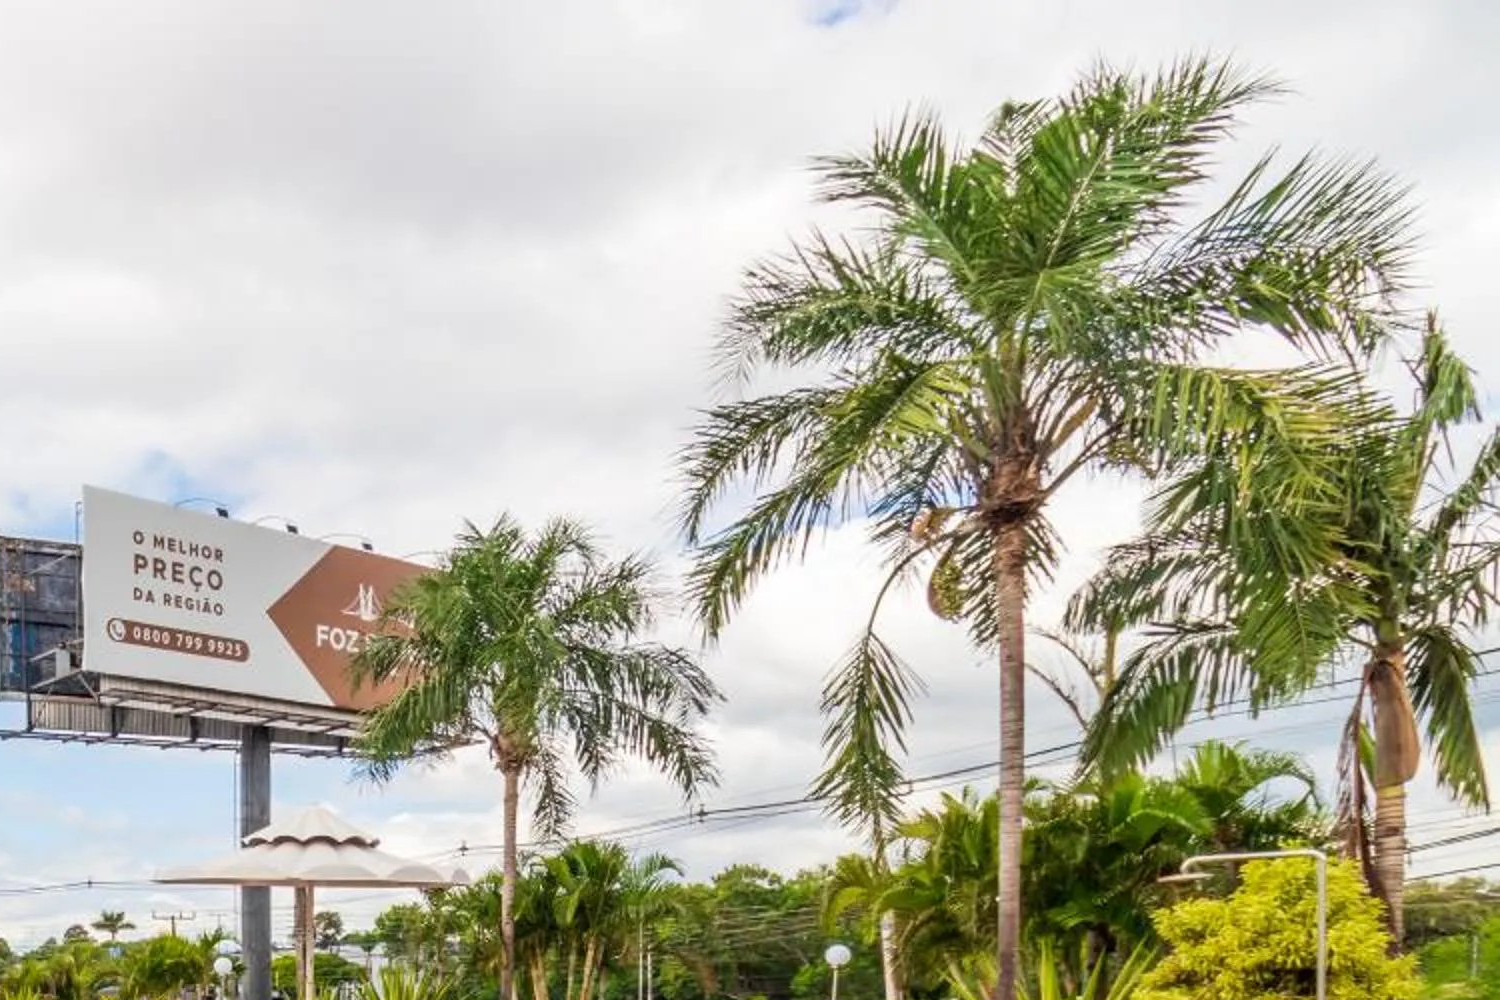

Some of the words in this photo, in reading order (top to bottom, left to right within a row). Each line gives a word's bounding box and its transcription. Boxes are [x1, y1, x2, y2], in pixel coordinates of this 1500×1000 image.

[132, 530, 145, 545] O
[153, 534, 224, 563] MELHOR
[133, 553, 224, 592] PREÇO
[133, 587, 156, 603] DA
[163, 592, 224, 616] REGIÃO
[132, 626, 171, 645] 0800
[175, 633, 203, 651] 799
[207, 639, 243, 658] 9925
[316, 624, 360, 653] FOZ
